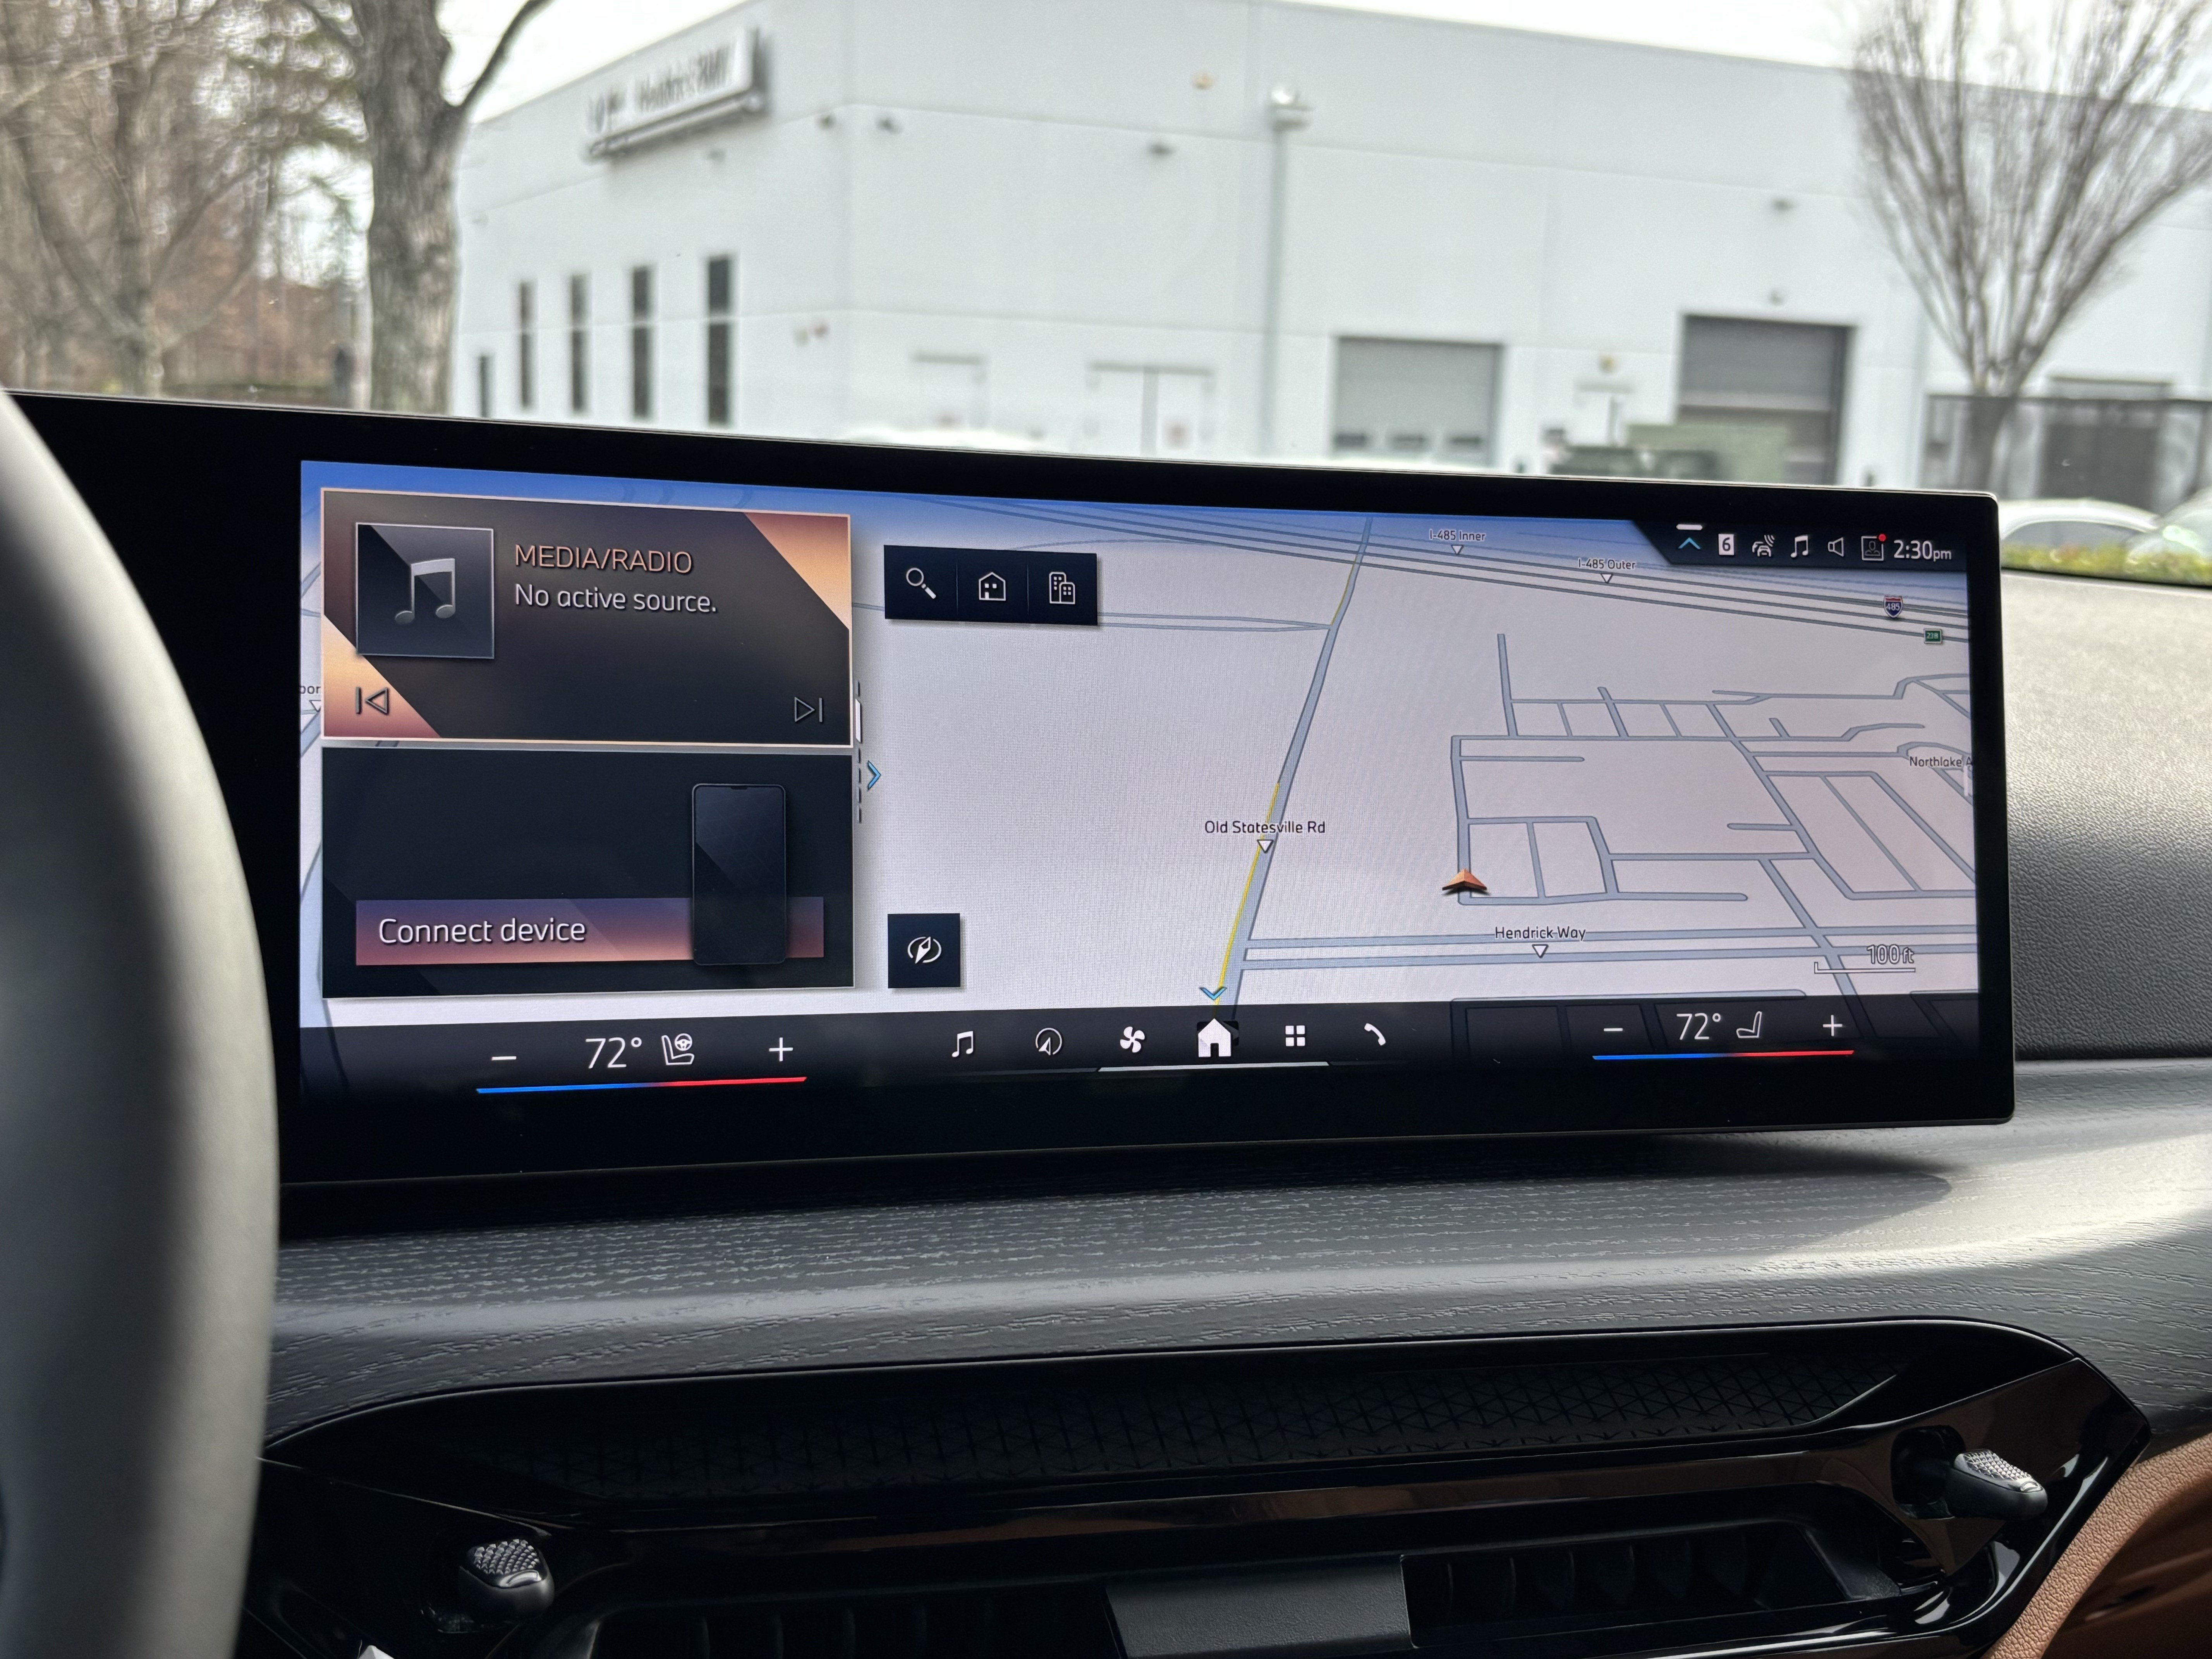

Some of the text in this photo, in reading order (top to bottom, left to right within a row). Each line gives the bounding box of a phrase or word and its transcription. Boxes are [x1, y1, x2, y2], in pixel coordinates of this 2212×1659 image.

[1429, 529, 1485, 541] I-485 Inner
[1722, 537, 1731, 552] 6
[1893, 540, 1952, 562] 2:30pm
[515, 544, 693, 573] MEDIA/RADIO
[1578, 558, 1636, 570] I-485 Outer
[515, 583, 717, 612] No active source.
[1886, 603, 1900, 611] 485
[1910, 756, 1962, 767] Northlake
[1204, 820, 1326, 834] Old Statesville Rd
[379, 917, 586, 944] Connect device
[1494, 926, 1586, 941] Hendrick Way
